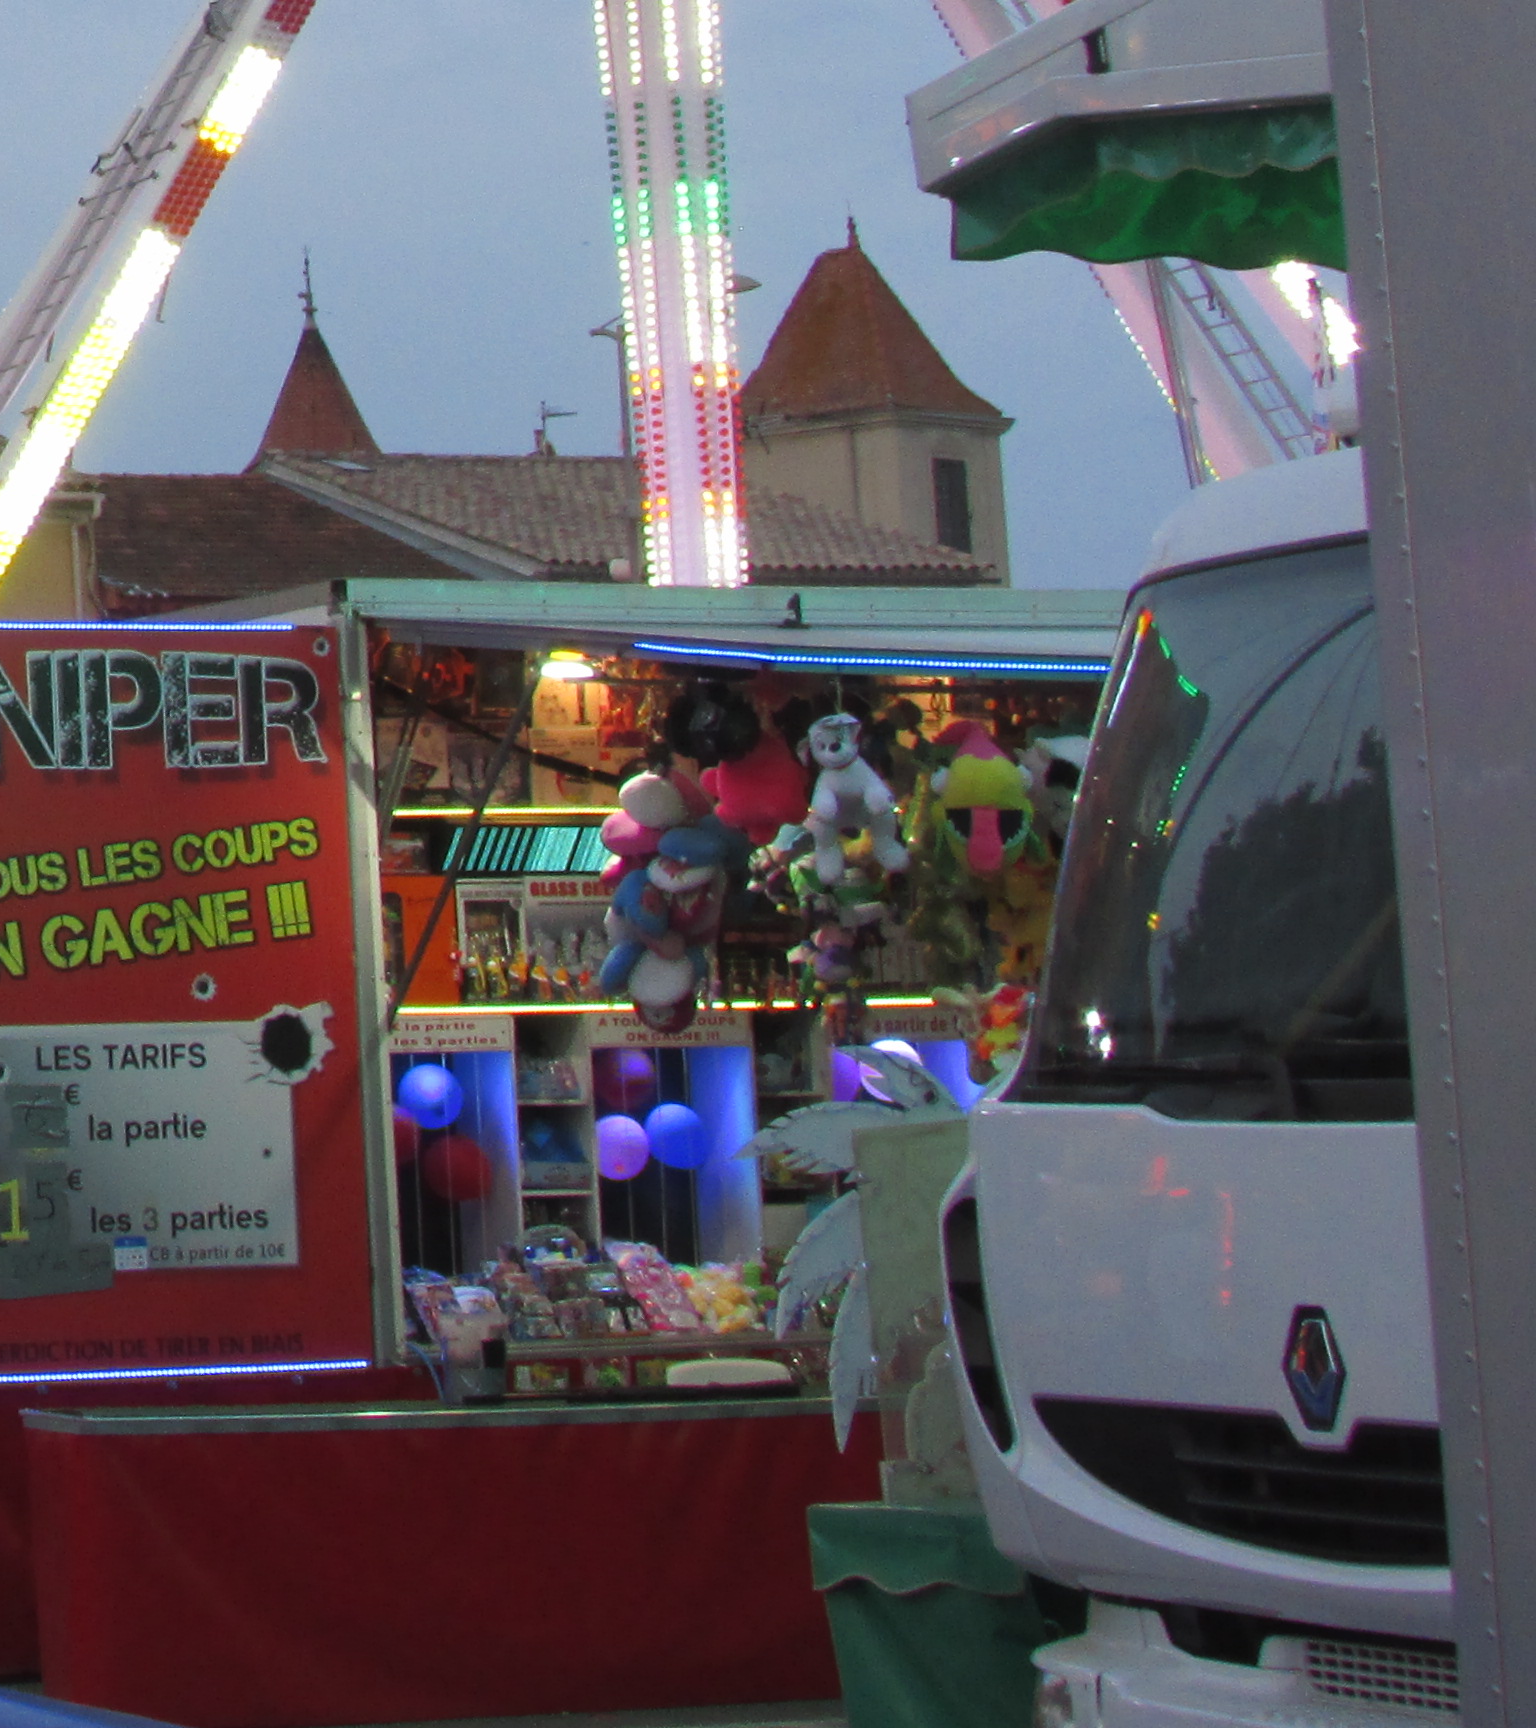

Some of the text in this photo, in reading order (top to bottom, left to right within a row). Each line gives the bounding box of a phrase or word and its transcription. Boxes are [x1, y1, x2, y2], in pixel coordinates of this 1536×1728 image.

[77, 839, 160, 887] LES
[172, 817, 318, 872] COUPS
[530, 881, 577, 896] GLASS
[40, 889, 254, 969] GAGNE
[265, 880, 312, 938] !!!
[405, 1022, 420, 1032] la
[425, 1022, 476, 1033] partie
[696, 1016, 736, 1026] OUPS
[394, 1037, 419, 1046] les
[437, 1036, 498, 1048] parties
[35, 1042, 208, 1072] LES TARIFS
[88, 1114, 113, 1142] la
[125, 1112, 207, 1148] partie
[90, 1206, 132, 1234] les
[142, 1206, 159, 1232] 3
[170, 1203, 270, 1239] parties
[149, 1245, 170, 1262] CB
[188, 1244, 229, 1264] partir
[234, 1243, 254, 1260] de
[259, 1243, 286, 1259] 10€
[121, 1339, 146, 1360] DE
[218, 1335, 246, 1356] EN
